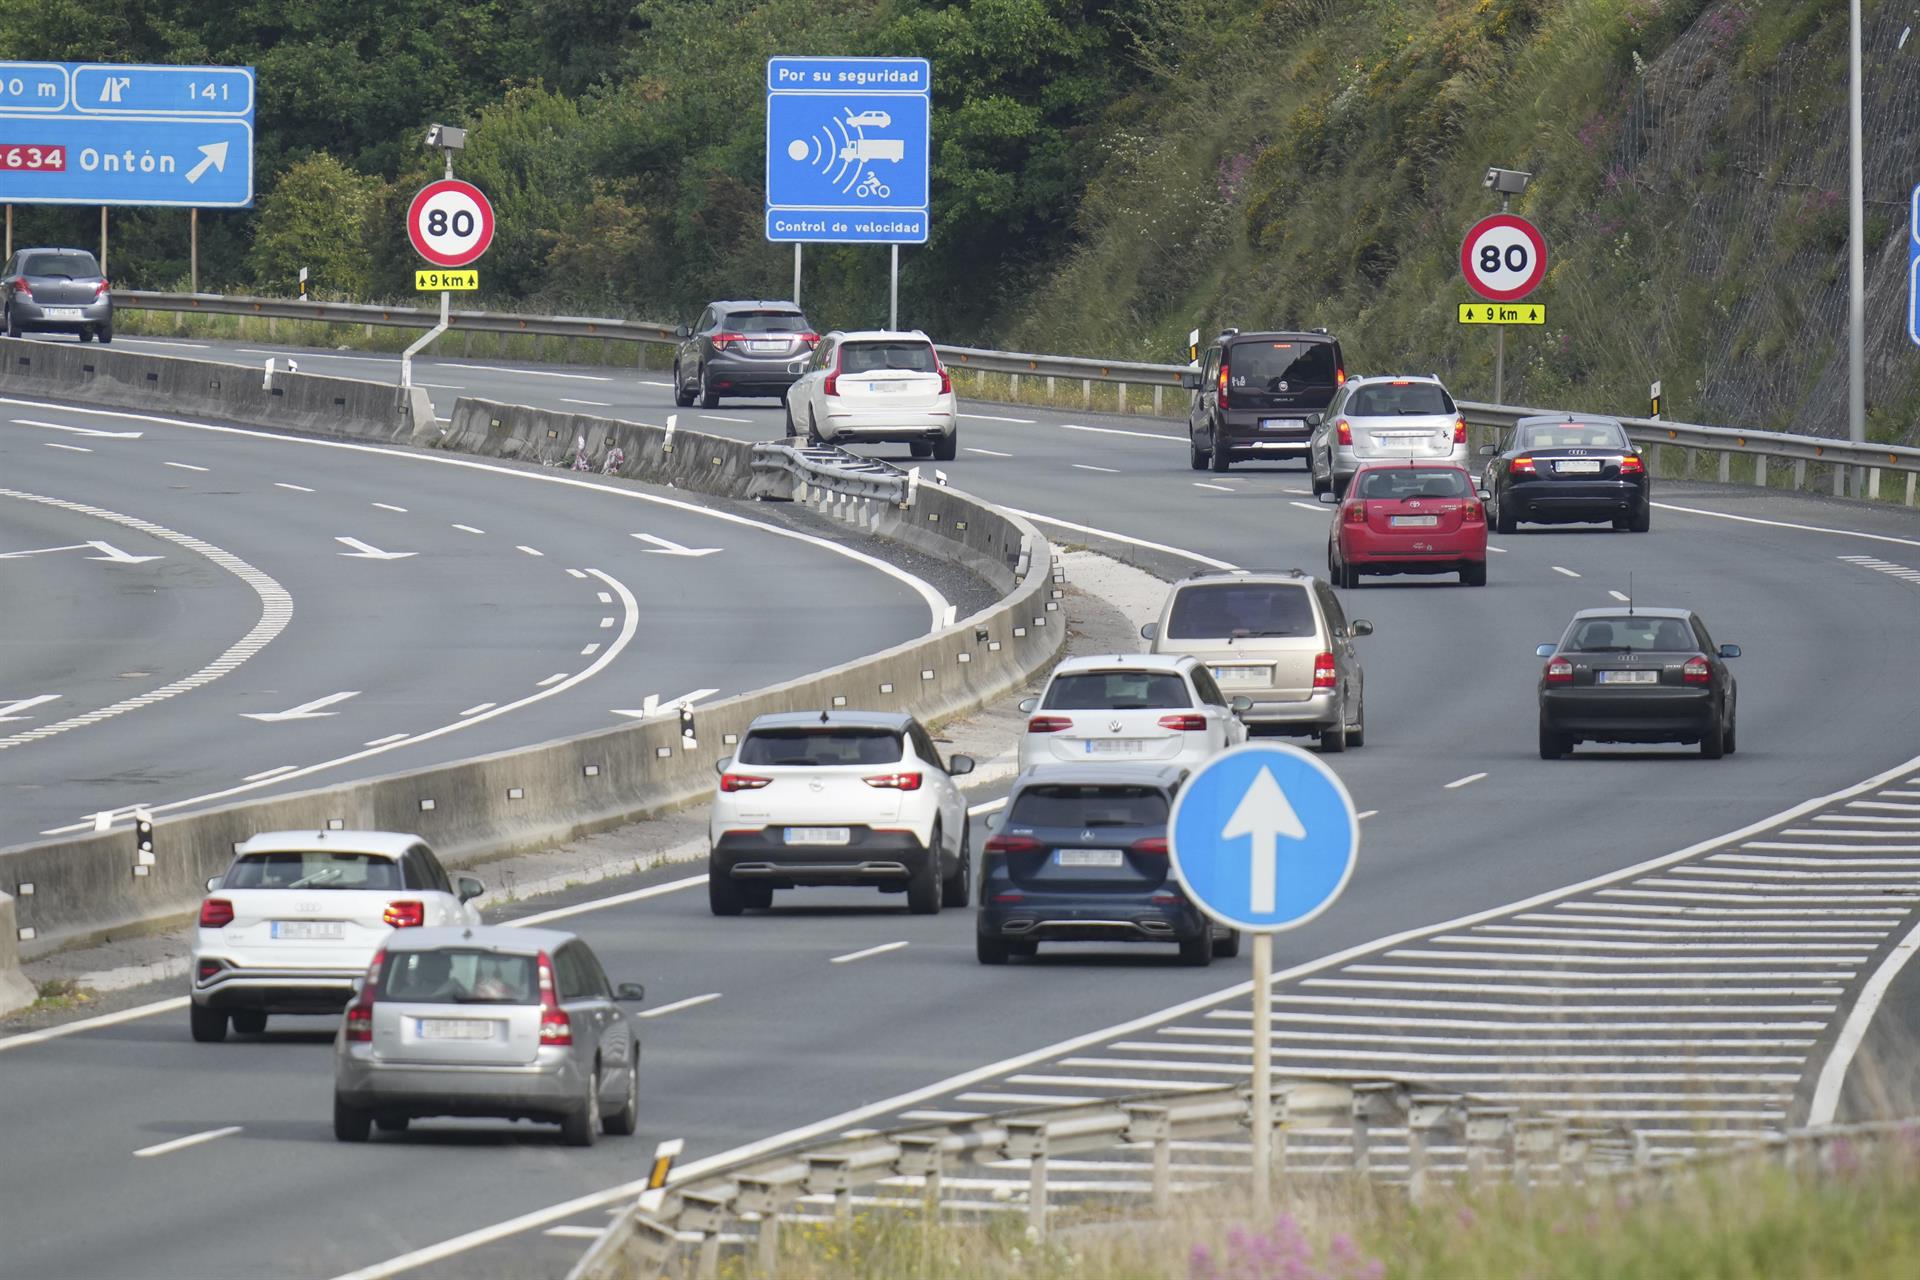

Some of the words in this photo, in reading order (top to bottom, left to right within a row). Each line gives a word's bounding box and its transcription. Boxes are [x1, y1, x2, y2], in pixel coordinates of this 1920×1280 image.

[779, 68, 806, 82] Por
[812, 71, 832, 82] su
[838, 69, 919, 85] seguridad
[0, 78, 24, 96] 0
[37, 82, 57, 97] m
[188, 82, 229, 101] 141
[79, 147, 176, 173] Ontón
[427, 208, 475, 238] 80
[775, 220, 826, 233] Control
[831, 221, 848, 233] de
[855, 221, 920, 234] velocidad
[1479, 243, 1528, 273] 80
[429, 274, 438, 287] 9
[442, 274, 463, 287] km
[1486, 307, 1494, 321] 9
[1499, 307, 1518, 321] km
